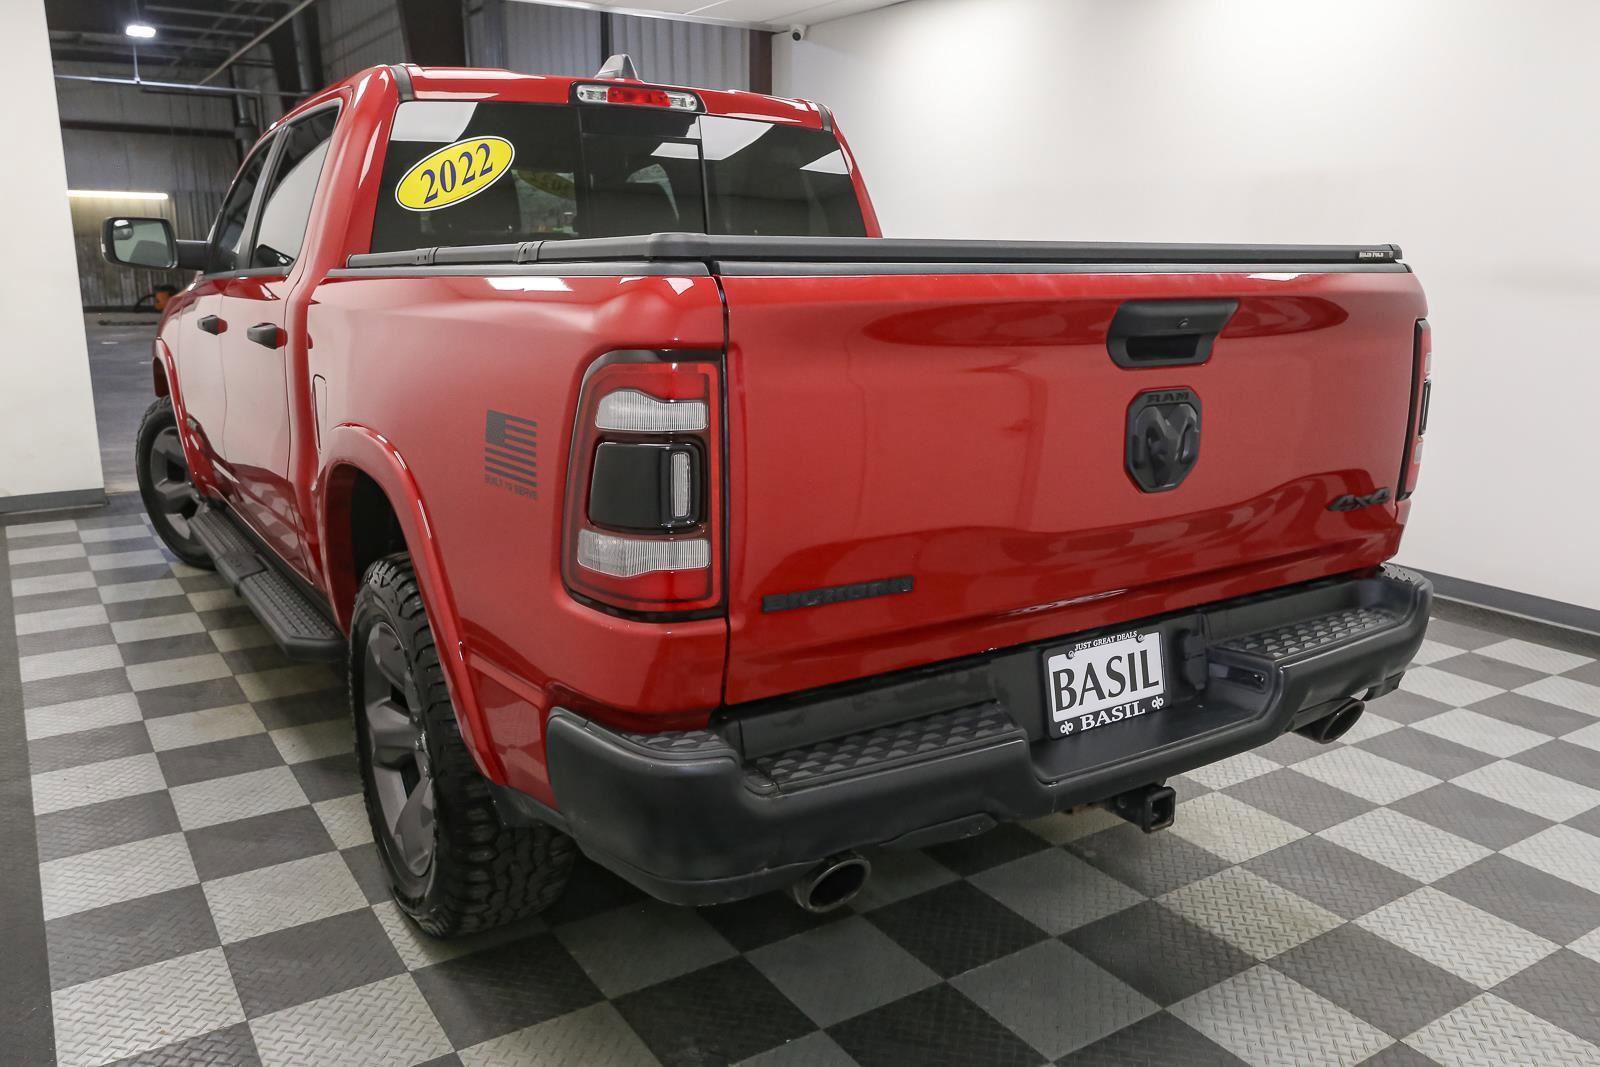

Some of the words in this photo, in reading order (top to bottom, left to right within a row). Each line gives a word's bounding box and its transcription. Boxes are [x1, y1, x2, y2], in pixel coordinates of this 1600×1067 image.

[420, 143, 493, 204] 2022
[1147, 391, 1189, 403] RAM
[1075, 641, 1094, 651] JUST
[1093, 635, 1116, 647] GREAT
[1116, 631, 1138, 641] DEALS
[1052, 649, 1160, 712] BASIL
[1080, 701, 1146, 731] BASIL
